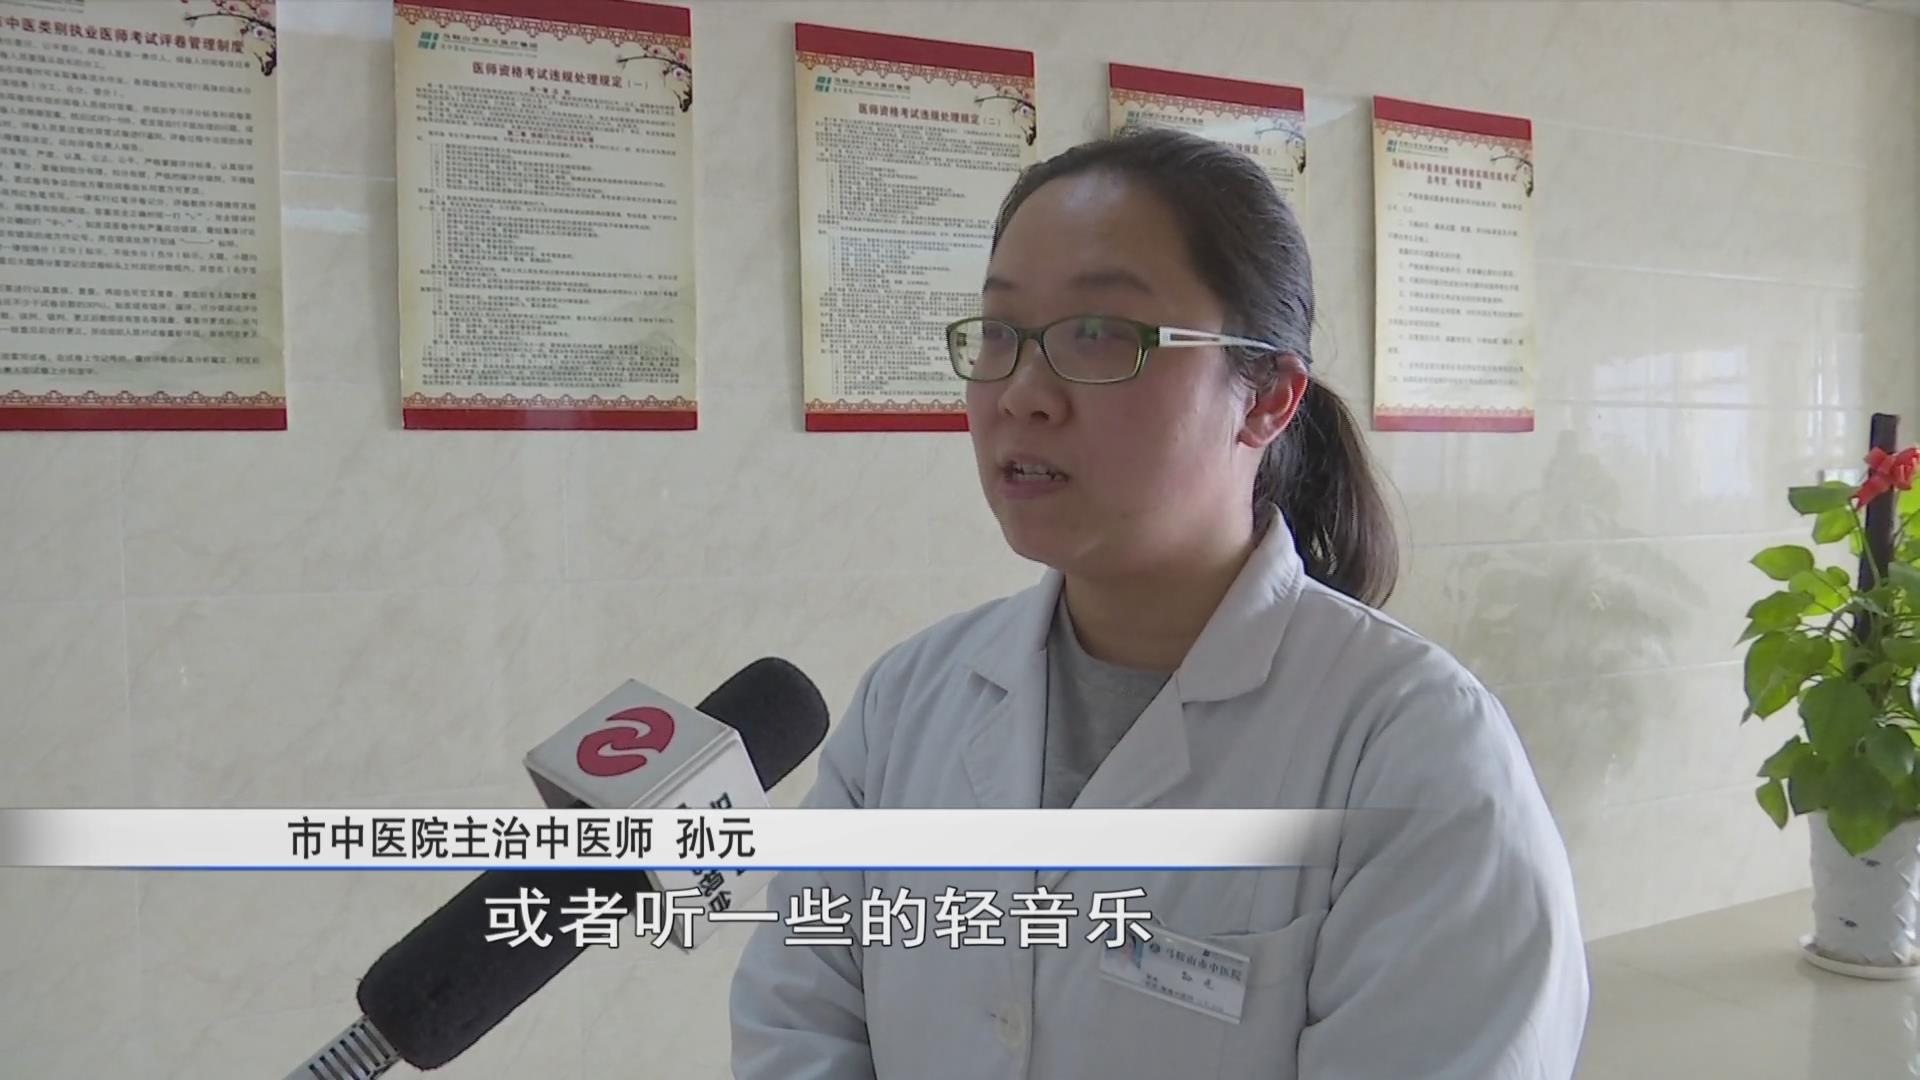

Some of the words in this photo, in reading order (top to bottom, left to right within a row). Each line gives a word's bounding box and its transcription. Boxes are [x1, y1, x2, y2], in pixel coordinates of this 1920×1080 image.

[0, 15, 244, 54] 中医类别执业医师考试评卷管理制度
